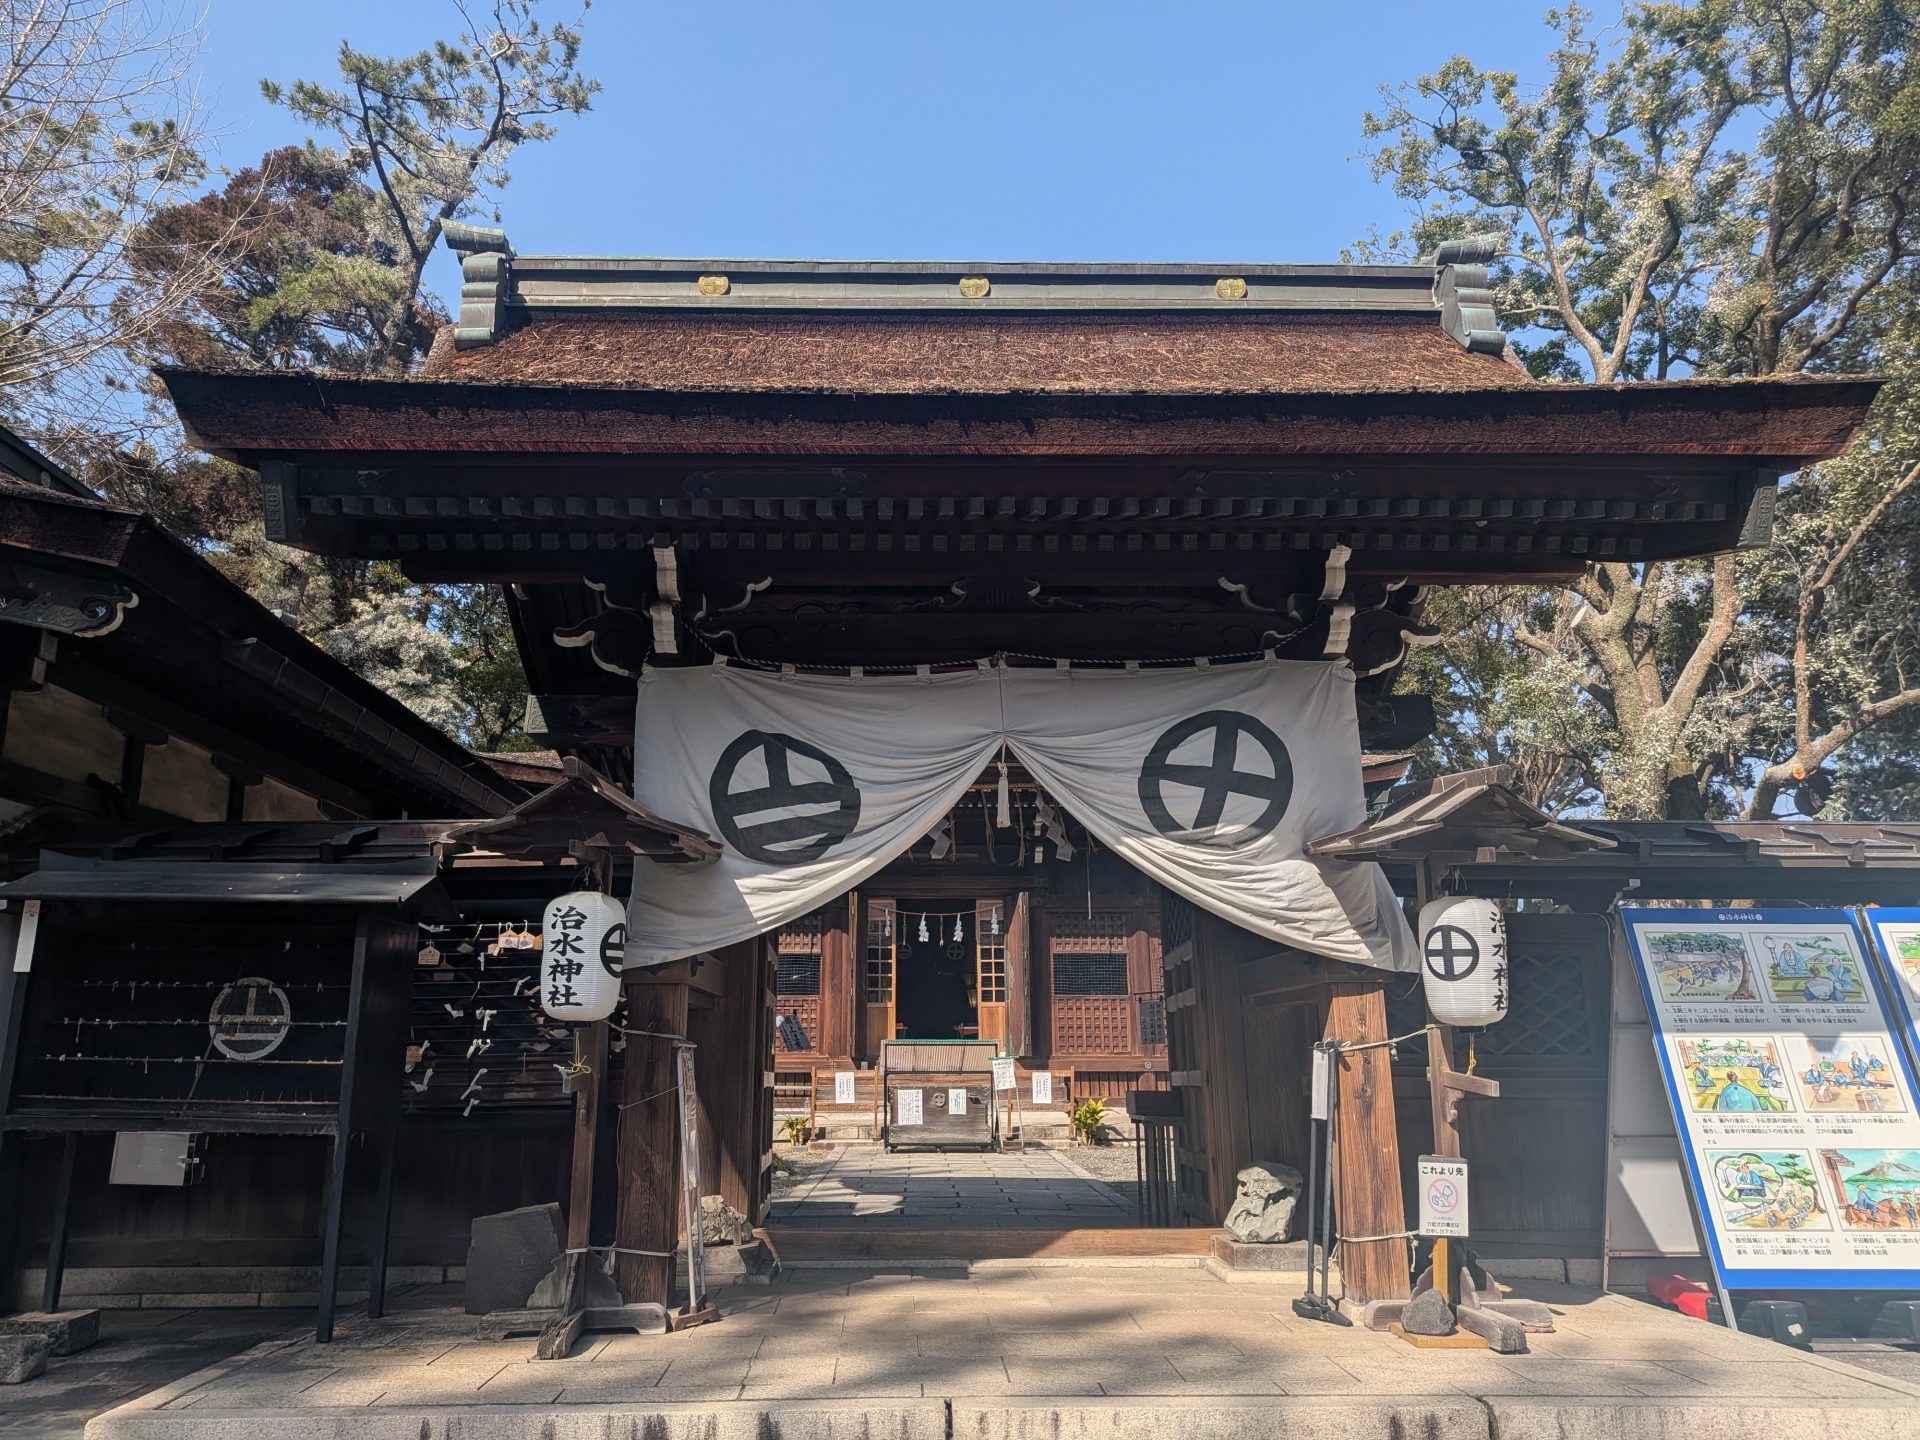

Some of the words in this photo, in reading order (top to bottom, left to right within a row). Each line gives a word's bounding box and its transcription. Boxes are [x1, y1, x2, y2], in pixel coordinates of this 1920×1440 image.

[546, 905, 588, 1008] 治水神社
[1421, 1165, 1465, 1177] これより先
